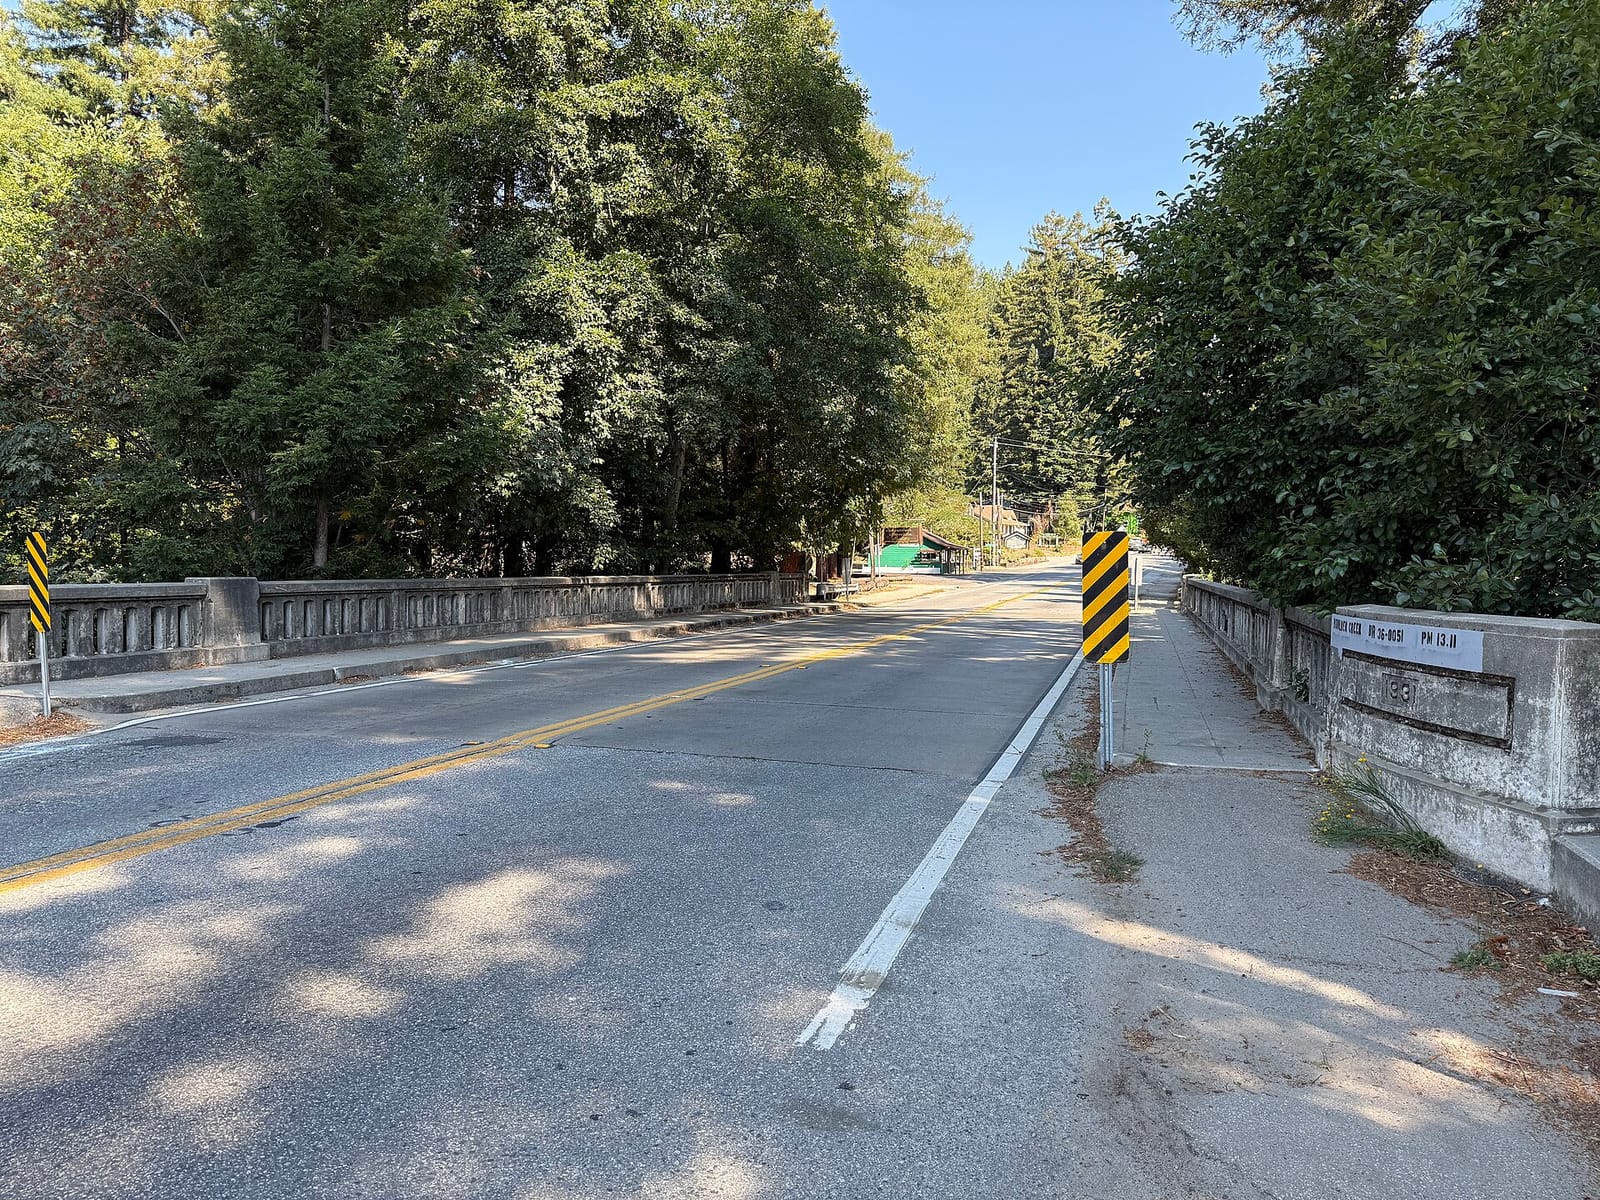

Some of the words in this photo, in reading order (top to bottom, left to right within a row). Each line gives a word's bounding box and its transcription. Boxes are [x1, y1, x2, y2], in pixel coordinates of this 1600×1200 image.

[1377, 627, 1404, 643] 36-0051
[1421, 631, 1433, 645] PM
[1437, 632, 1457, 648] 13.11
